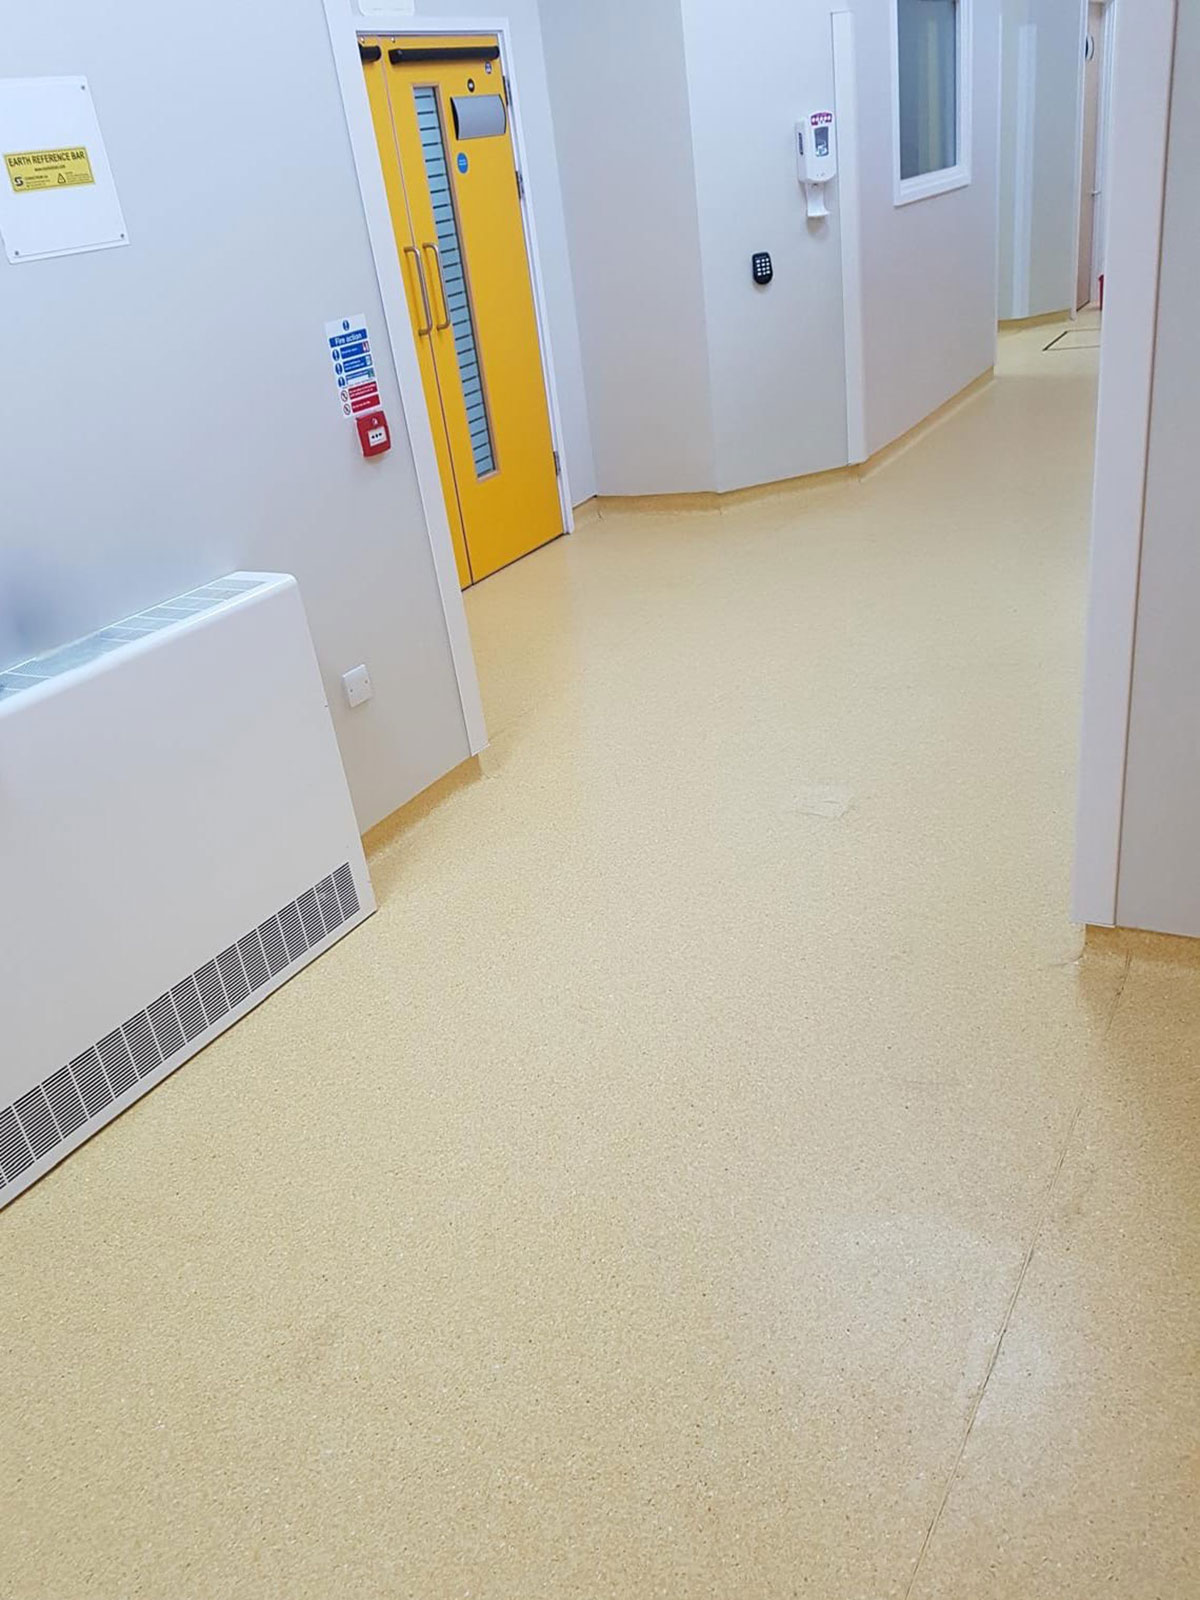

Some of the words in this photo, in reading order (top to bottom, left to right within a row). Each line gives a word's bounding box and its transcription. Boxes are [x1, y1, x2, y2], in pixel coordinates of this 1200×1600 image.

[8, 156, 32, 167] EARTH
[32, 152, 71, 164] REFERENCE
[71, 151, 85, 160] BAR
[335, 337, 346, 345] Fire
[346, 333, 363, 342] action
